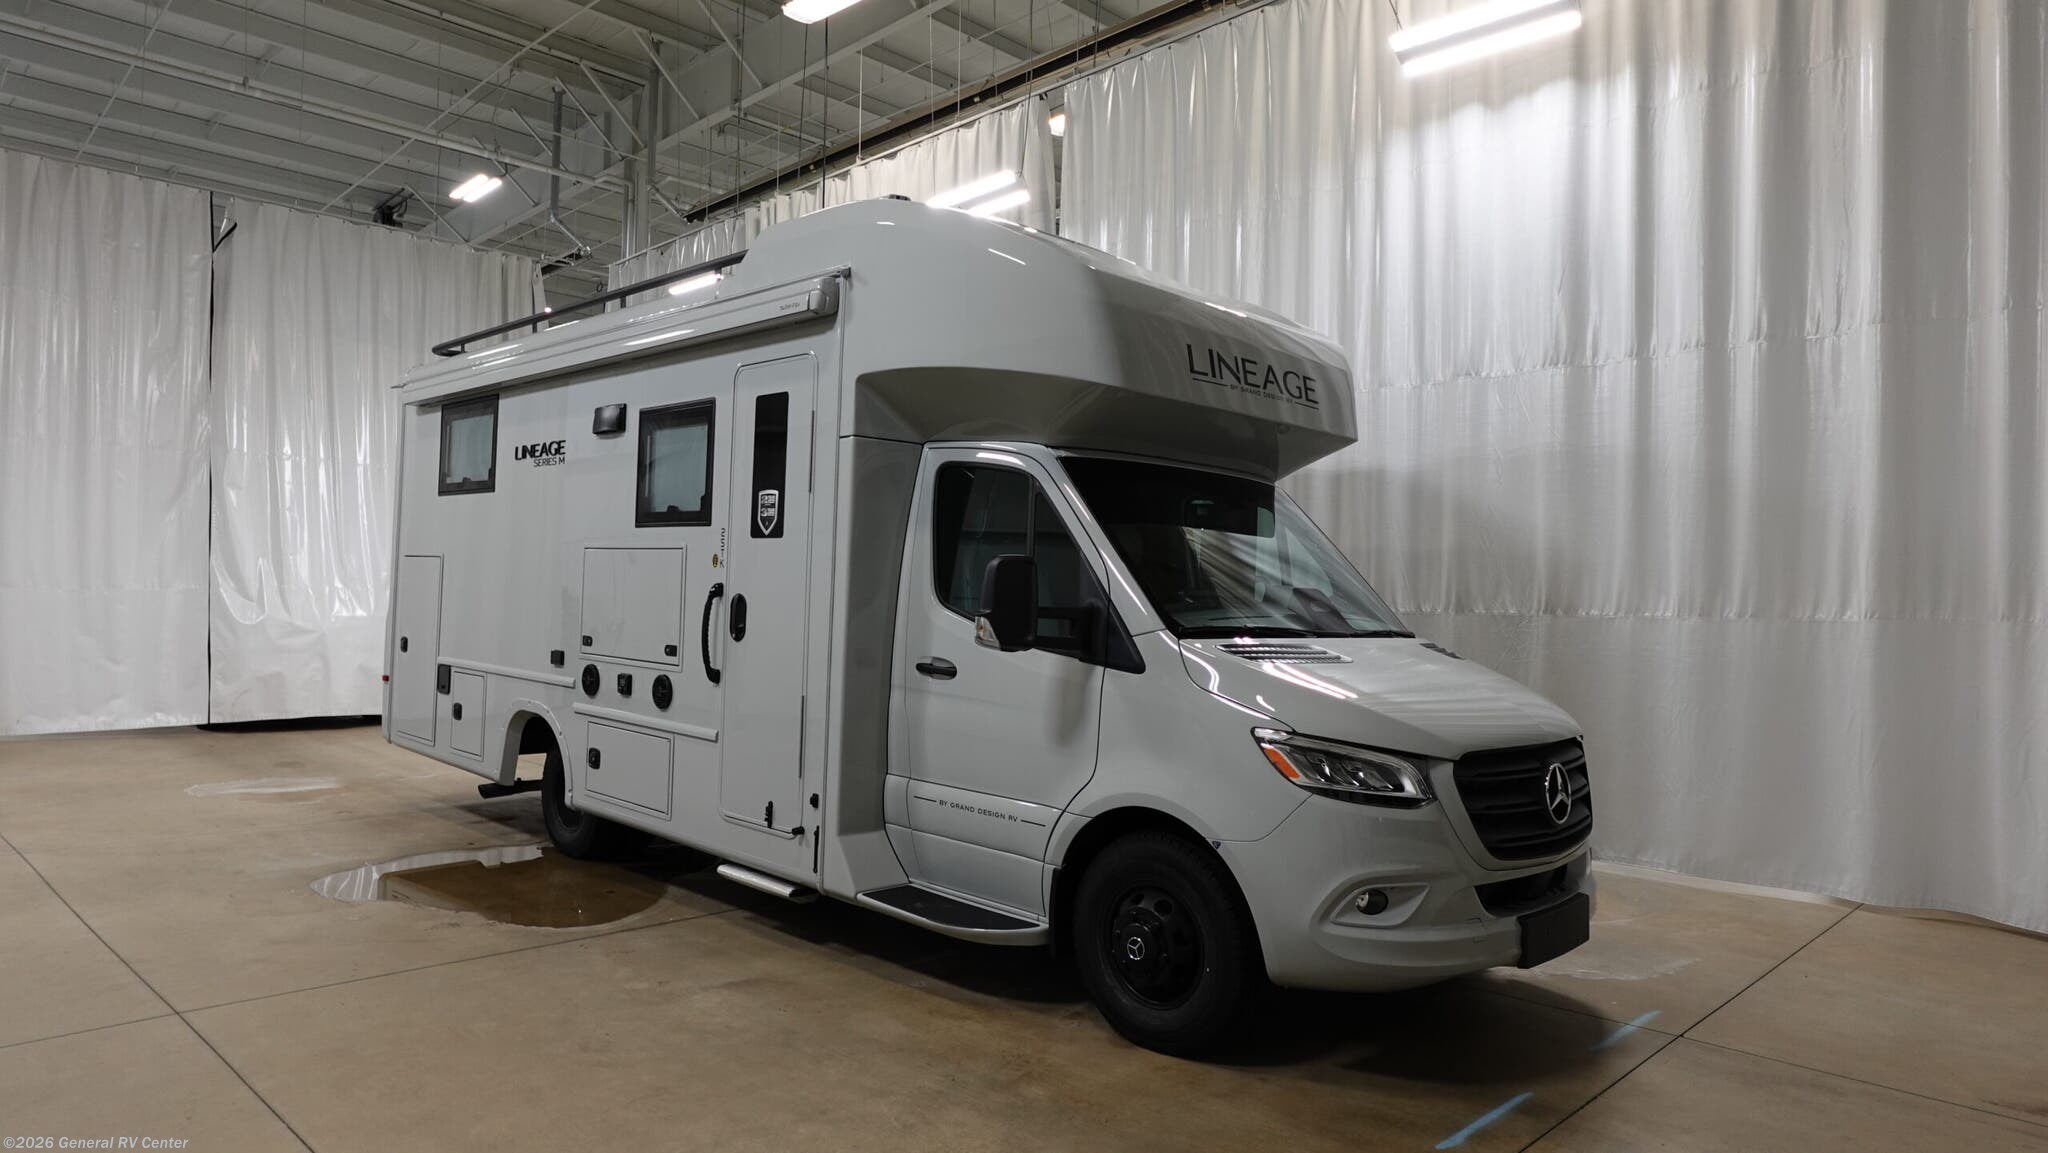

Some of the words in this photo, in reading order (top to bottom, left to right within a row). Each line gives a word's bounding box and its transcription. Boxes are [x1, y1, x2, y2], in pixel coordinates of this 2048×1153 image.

[1186, 343, 1319, 405] LINEAGE
[515, 440, 567, 461] LINEAGE
[533, 457, 557, 468] SERIES
[558, 456, 566, 465] M
[939, 799, 949, 807] BY
[950, 802, 976, 813] GRAND
[977, 808, 1006, 820] DESIGN
[1008, 814, 1018, 822] RV
